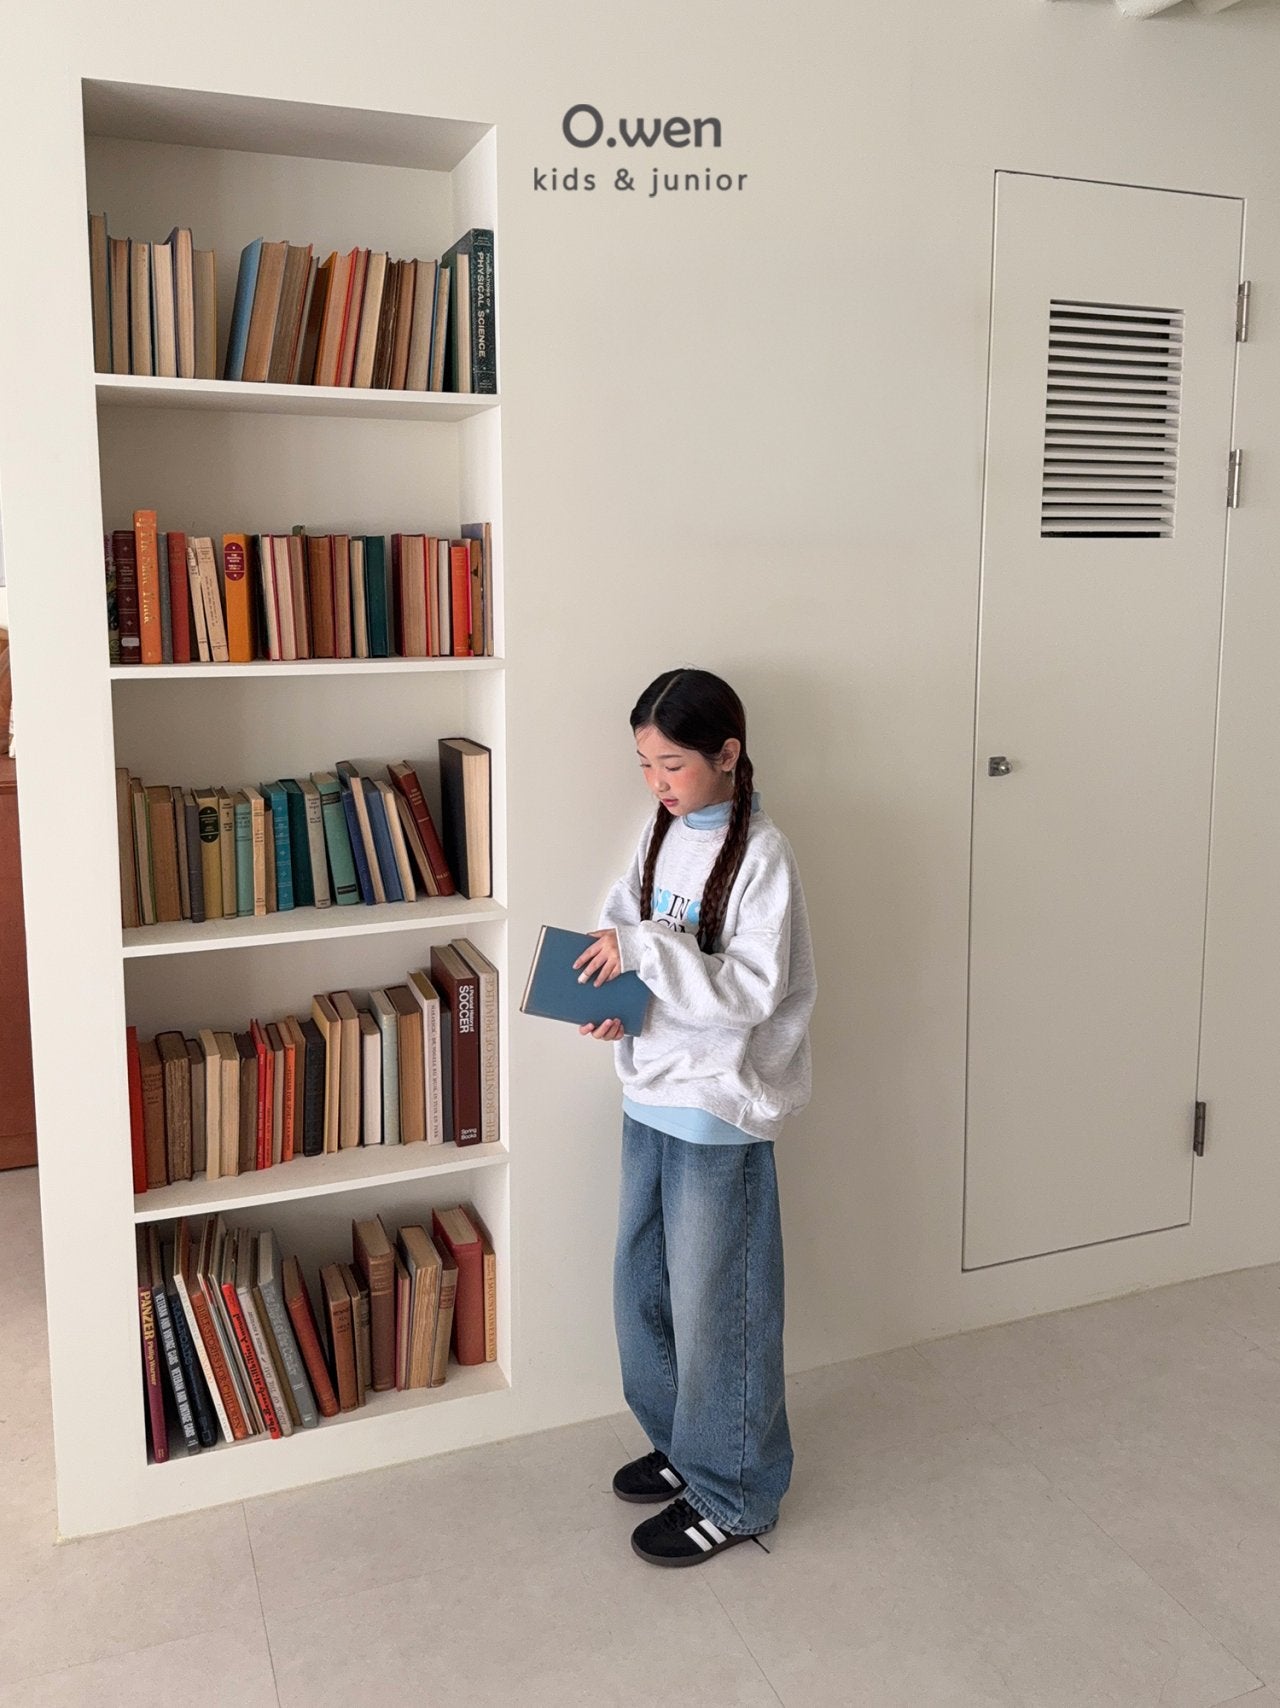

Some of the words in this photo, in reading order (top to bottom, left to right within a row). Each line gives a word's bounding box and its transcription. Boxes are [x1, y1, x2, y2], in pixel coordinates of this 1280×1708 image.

[476, 251, 484, 306] PHYSICAL
[477, 310, 486, 357] SCIENCE
[459, 985, 469, 1033] SOCCER
[485, 978, 494, 1031] PRIVILEGE
[486, 1057, 495, 1113] FRONTIERS
[140, 1291, 155, 1339] PANZER
[155, 1292, 168, 1317] VETERAN
[197, 1303, 210, 1327] BIBLE
[161, 1316, 171, 1329] AND
[170, 1300, 193, 1365] RAILROADS
[233, 1313, 248, 1344] Annual
[146, 1341, 155, 1360] Philip
[162, 1328, 176, 1351] VINTAGE
[203, 1326, 220, 1363] STORIES
[167, 1350, 179, 1365] CARS
[148, 1360, 157, 1385] Warner
[171, 1367, 185, 1391] VETERAN
[215, 1365, 227, 1383] FOR
[176, 1390, 187, 1403] AND
[222, 1384, 242, 1429] CHILDREN
[257, 1387, 272, 1417] Beverly
[178, 1402, 192, 1424] VINTAGE
[183, 1422, 195, 1437] CARS
